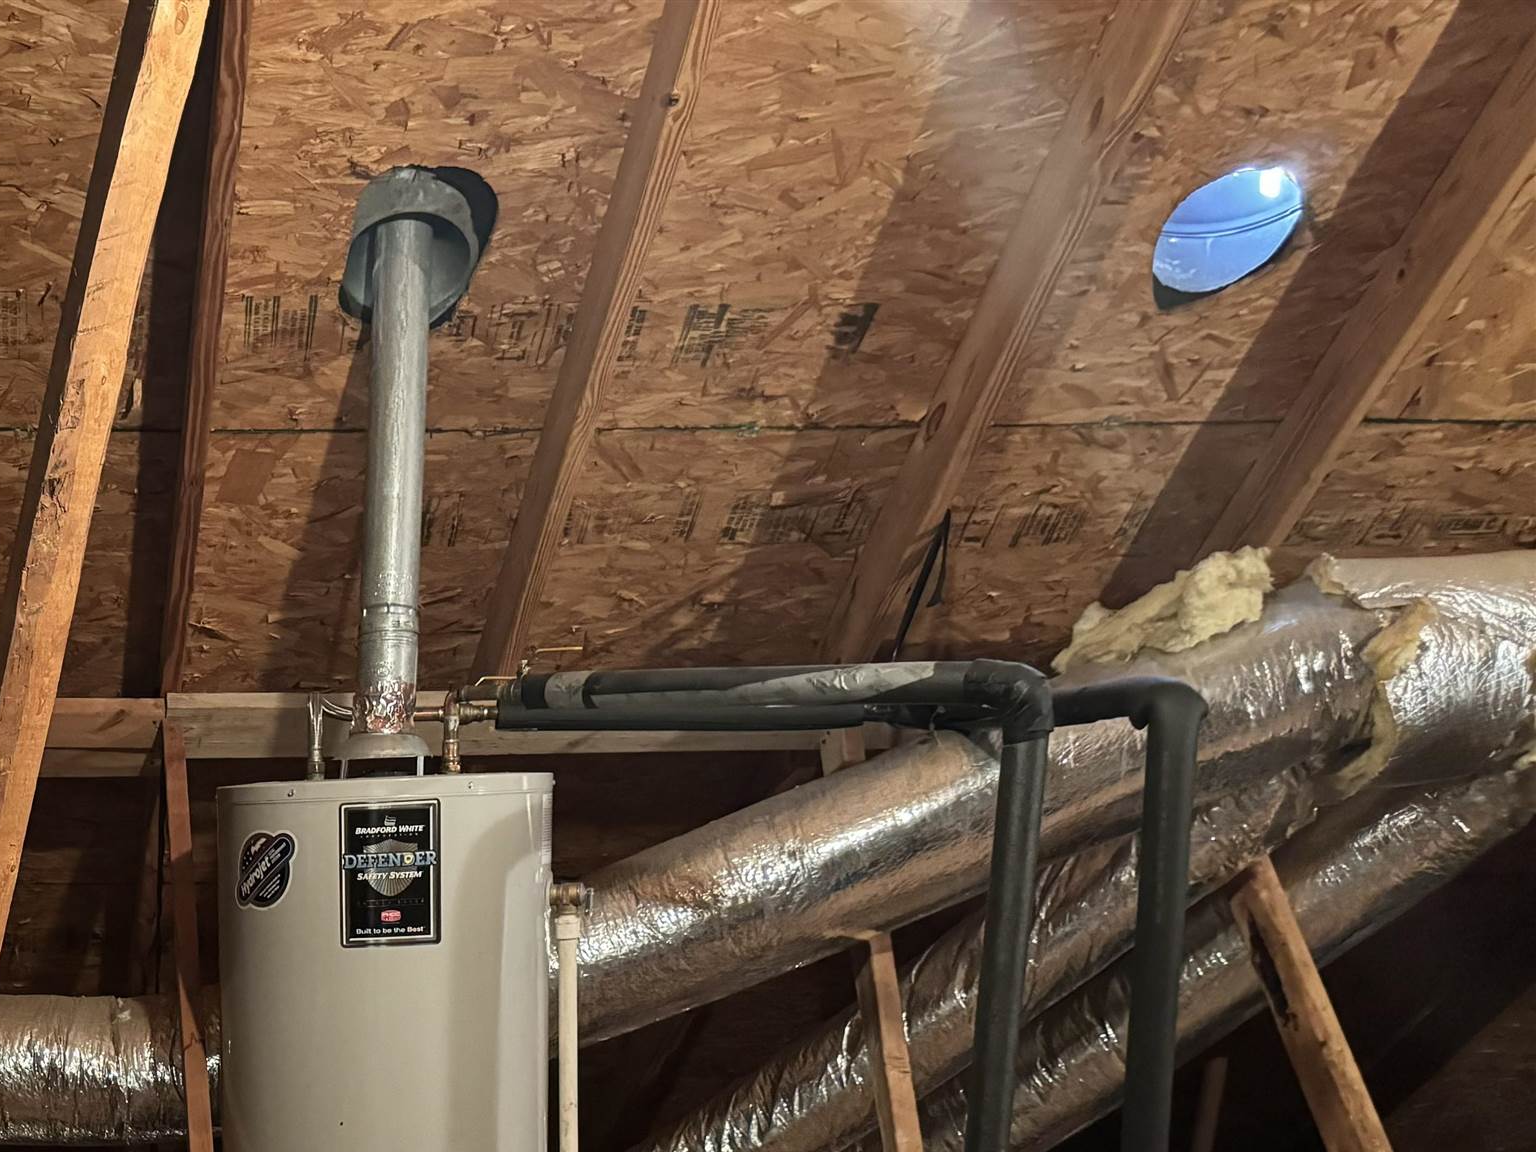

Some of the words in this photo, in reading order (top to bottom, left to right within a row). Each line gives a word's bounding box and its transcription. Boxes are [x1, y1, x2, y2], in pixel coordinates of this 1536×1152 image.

[355, 826, 397, 835] BRADFORD
[343, 851, 437, 869] DEFENDER
[240, 856, 271, 897] Hydrojet
[357, 872, 387, 880] SAFETY
[388, 871, 423, 879] SYSTEM
